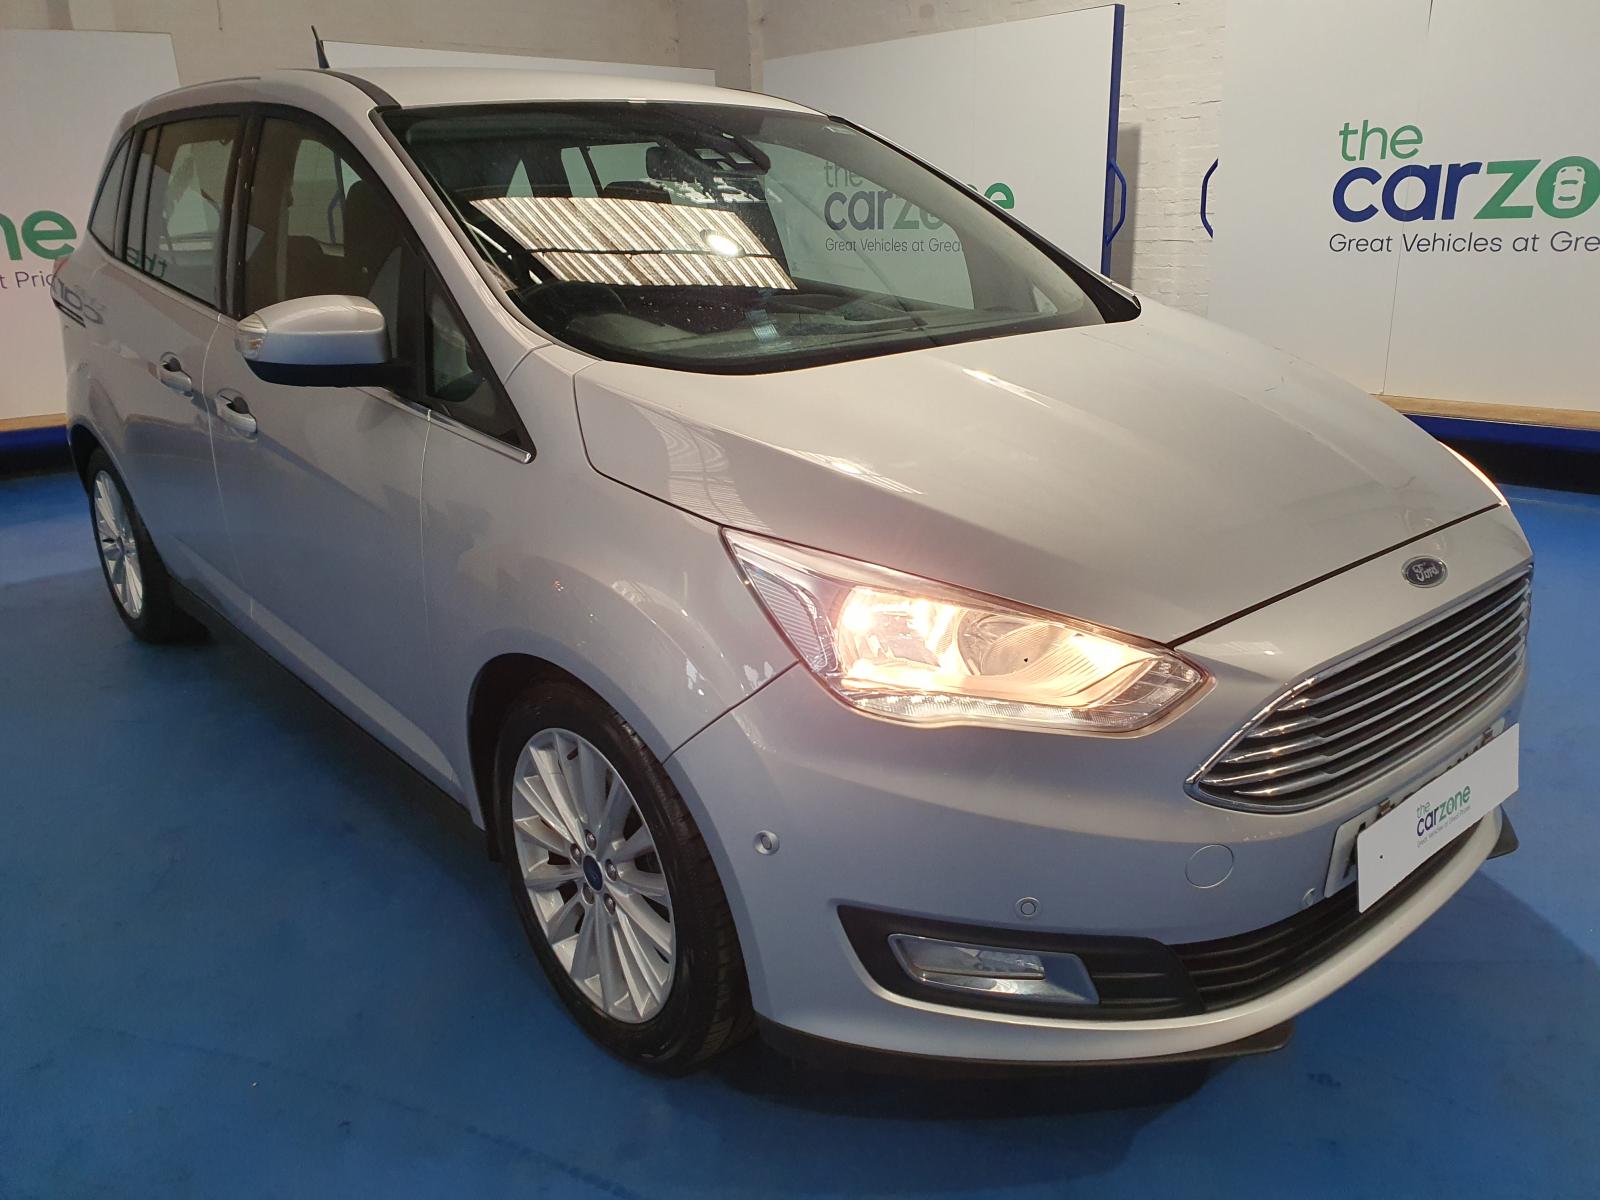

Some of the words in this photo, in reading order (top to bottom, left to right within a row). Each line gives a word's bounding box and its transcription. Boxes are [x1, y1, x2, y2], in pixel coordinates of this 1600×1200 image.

[1338, 119, 1423, 161] the
[1332, 155, 1600, 222] carzo
[825, 237, 857, 252] Great
[860, 238, 908, 252] Vehicles
[911, 240, 925, 252] at
[1329, 232, 1392, 252] Great
[1402, 232, 1502, 252] Vehicles
[1512, 232, 1540, 252] at
[1412, 562, 1440, 582] Ford
[1416, 801, 1431, 818] the
[1416, 785, 1471, 837] carzone
